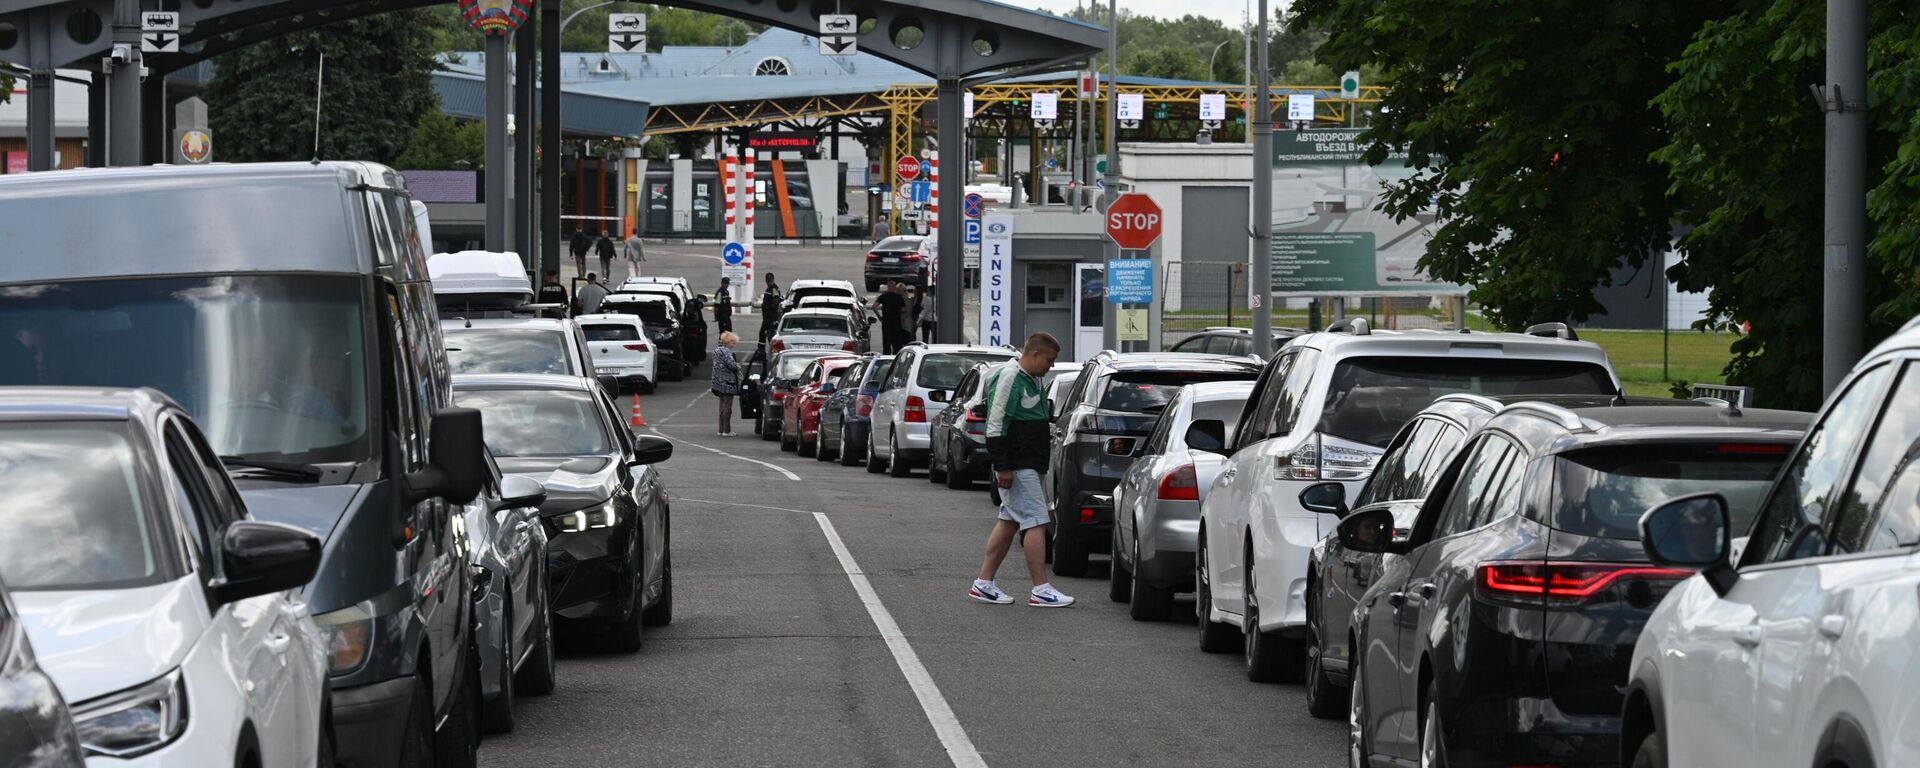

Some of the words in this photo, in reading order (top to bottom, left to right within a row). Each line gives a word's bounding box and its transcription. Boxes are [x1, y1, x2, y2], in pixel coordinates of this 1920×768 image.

[1315, 143, 1347, 152] ВЪЕЗД
[1348, 143, 1355, 151] В
[1278, 153, 1334, 161] РЕСПУБЛИКАНСКИЙ
[898, 163, 919, 172] STOP
[1110, 213, 1159, 230] STOP
[1109, 260, 1152, 269] ВНИМАНИЕ!
